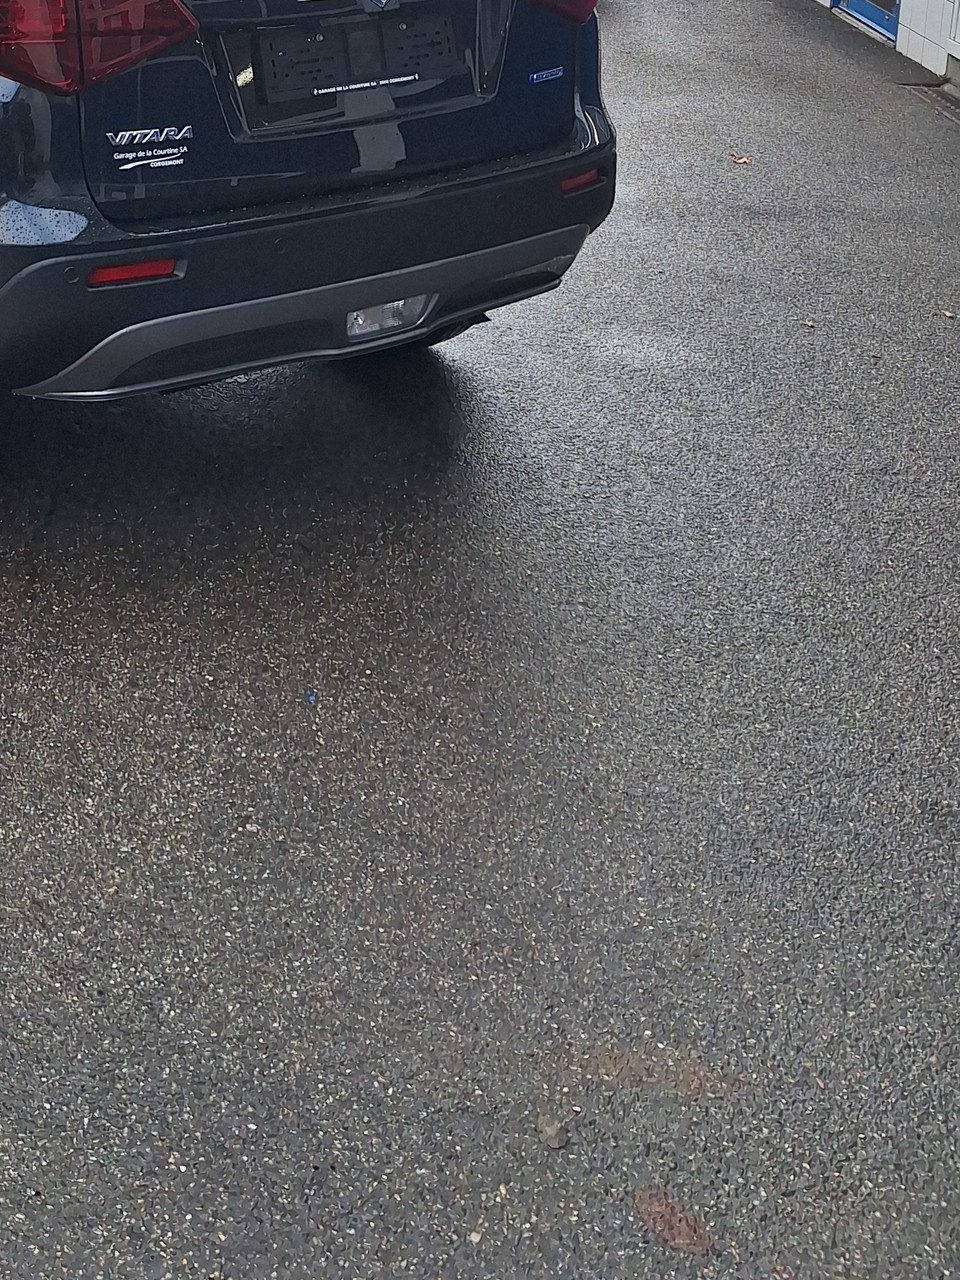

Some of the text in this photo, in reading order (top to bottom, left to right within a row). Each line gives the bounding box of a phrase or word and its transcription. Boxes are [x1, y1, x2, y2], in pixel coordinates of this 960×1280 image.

[106, 125, 193, 146] VITARA
[113, 152, 136, 160] Garage
[152, 147, 179, 155] Courtine
[179, 145, 188, 153] SA
[150, 158, 184, 167] CORGEMONT
